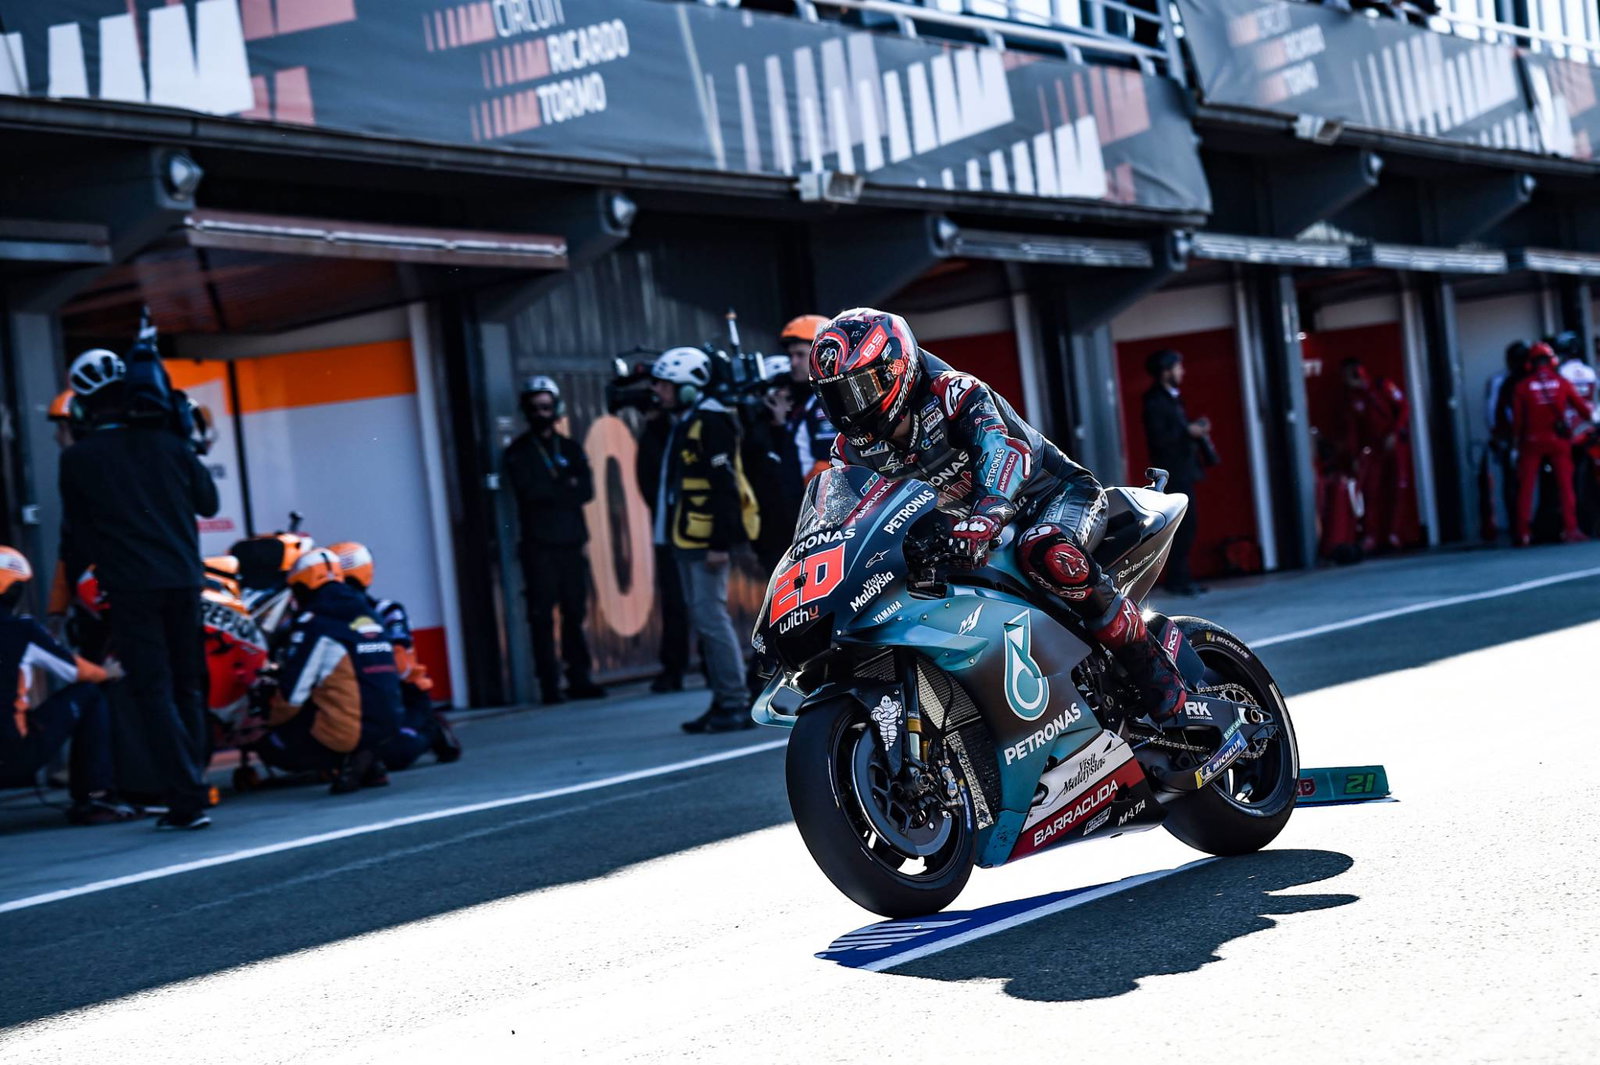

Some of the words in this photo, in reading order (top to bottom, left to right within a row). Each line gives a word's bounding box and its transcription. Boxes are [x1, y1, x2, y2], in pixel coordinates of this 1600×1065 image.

[546, 18, 630, 74] RICARDO
[536, 71, 607, 125] TORMO
[863, 332, 883, 358] BS
[817, 373, 845, 385] PETRONAS
[984, 447, 1006, 488] PETRONAS
[1000, 453, 1017, 492] BARRACUDA
[883, 490, 935, 535] PETRONAS
[769, 541, 846, 629] 20
[850, 571, 895, 613] Malaysia
[863, 573, 881, 589] Visit
[779, 605, 819, 635] withu
[872, 600, 903, 624] YAMAHA
[1215, 635, 1250, 659] MICHELIN
[1184, 701, 1212, 716] RK
[1004, 702, 1082, 766] PETRONAS
[1079, 753, 1096, 773] Visit
[1212, 738, 1242, 772] MICHELIN
[1061, 758, 1105, 796] Malaysia
[1344, 773, 1375, 794] 21
[1033, 779, 1119, 847] BARRACUDA
